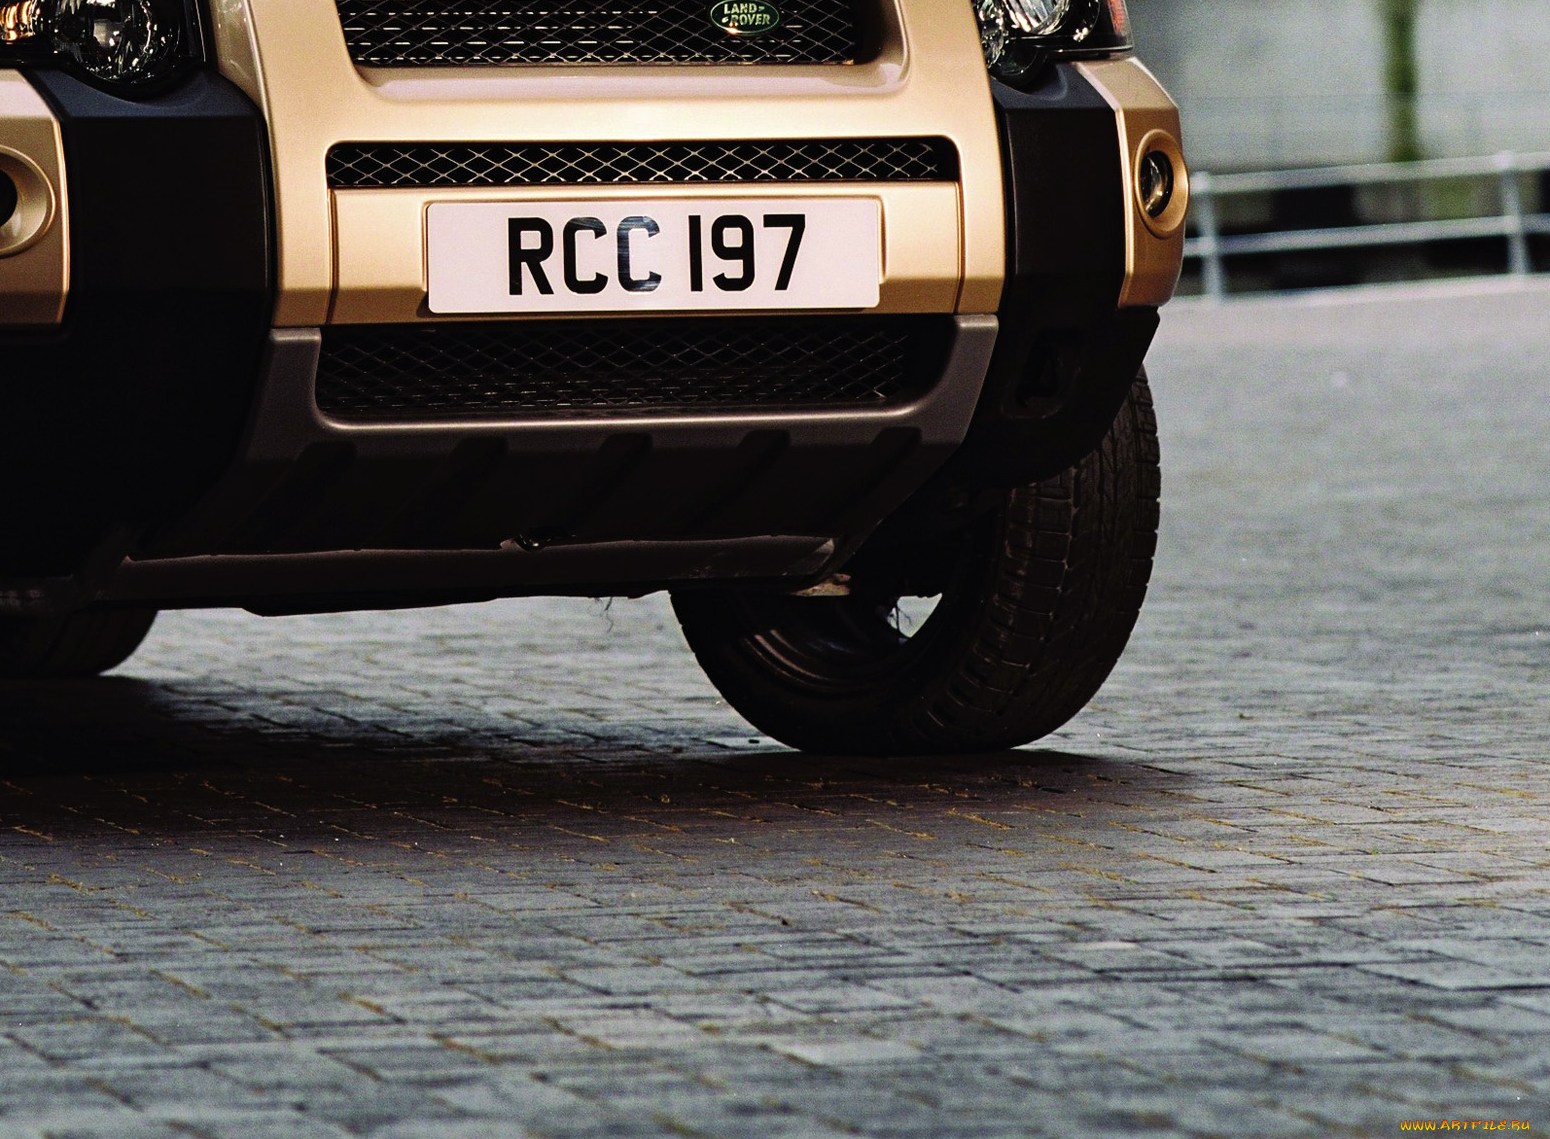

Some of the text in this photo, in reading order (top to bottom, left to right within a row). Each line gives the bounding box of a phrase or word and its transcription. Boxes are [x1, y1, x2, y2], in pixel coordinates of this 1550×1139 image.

[729, 14, 770, 26] ROVER
[508, 213, 806, 296] RCC 197
